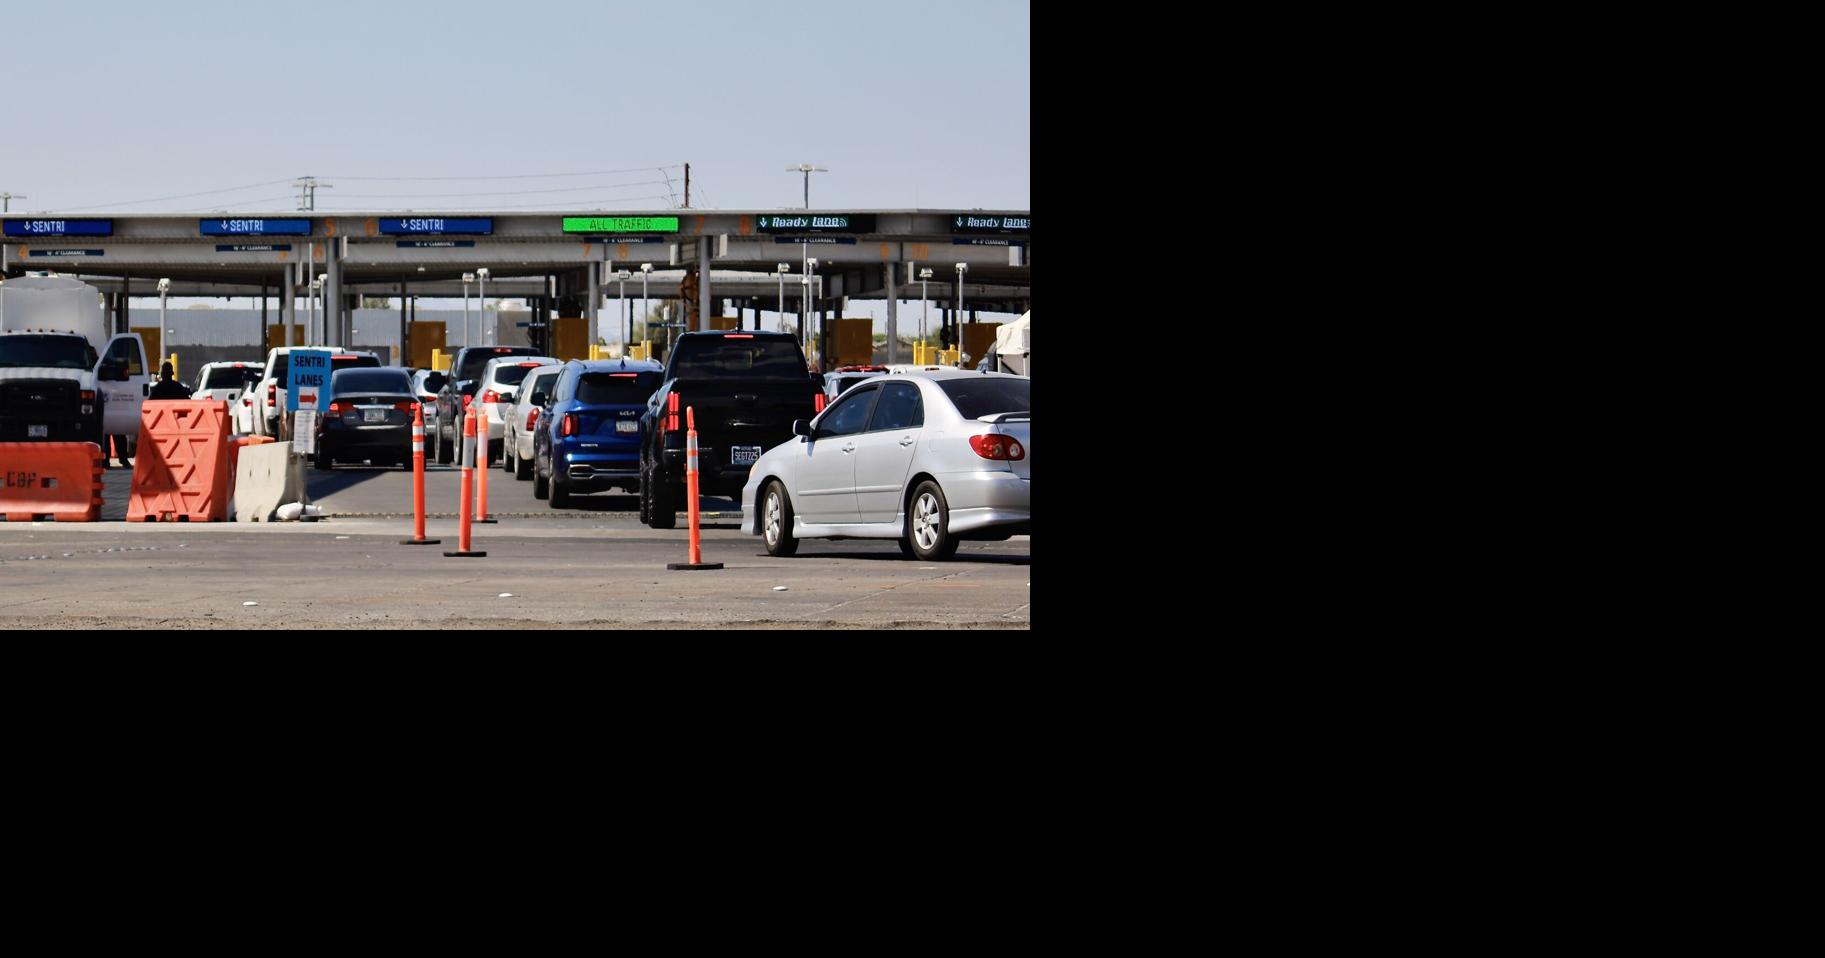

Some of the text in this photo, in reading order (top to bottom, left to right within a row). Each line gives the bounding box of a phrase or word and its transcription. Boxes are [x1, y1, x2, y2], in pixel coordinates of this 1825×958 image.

[32, 220, 65, 232] SENTRI
[230, 219, 264, 232] SENTRI
[324, 216, 337, 237] 5
[410, 219, 444, 231] SENTRI
[590, 219, 652, 230] ALL TRAFFIC
[772, 216, 839, 228] Ready Lane
[967, 217, 1027, 228] Ready Lane
[294, 355, 325, 368] SENTRI
[295, 374, 323, 386] LANES
